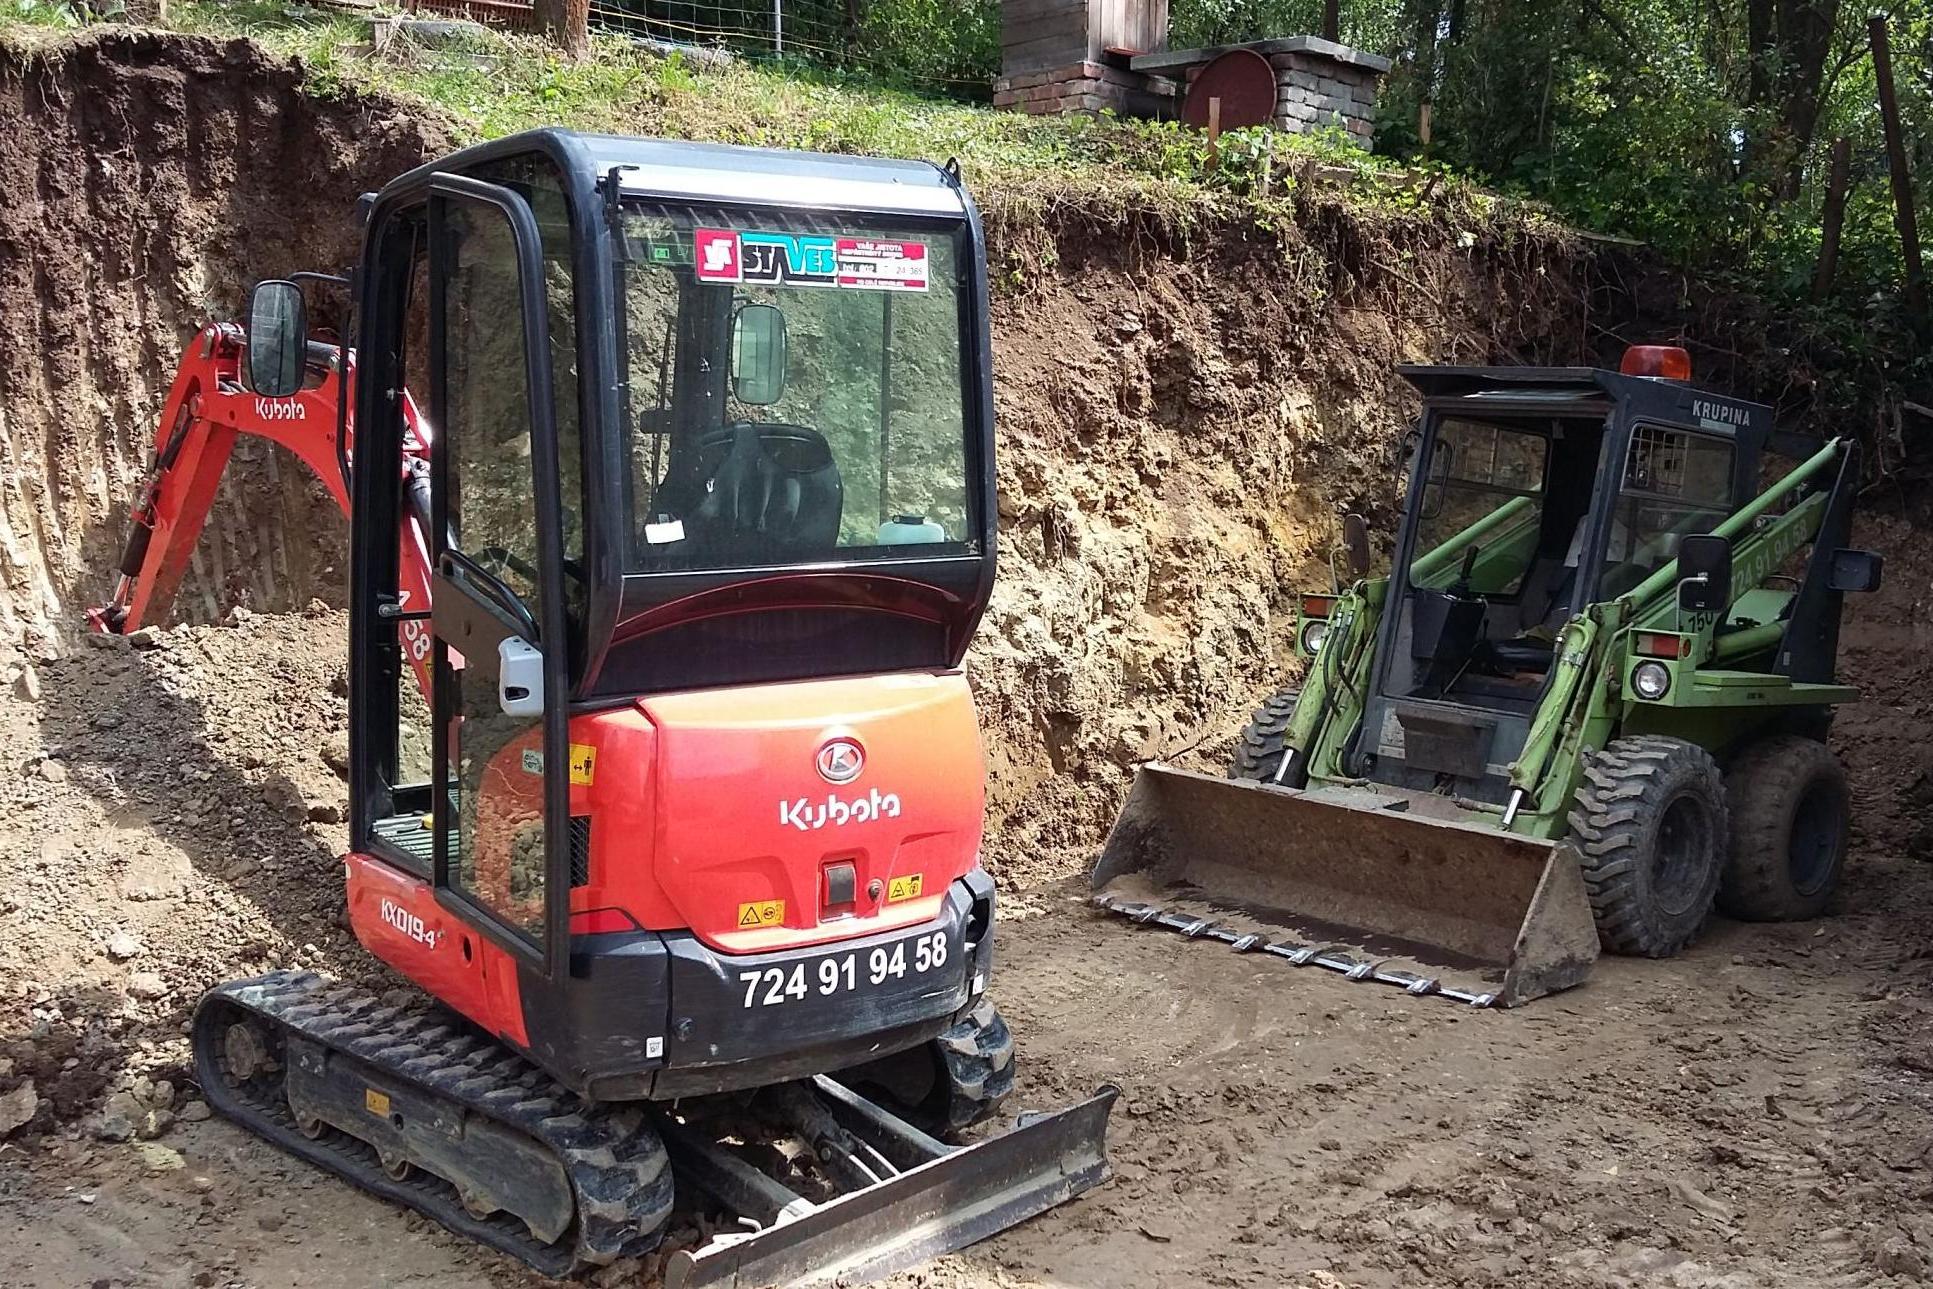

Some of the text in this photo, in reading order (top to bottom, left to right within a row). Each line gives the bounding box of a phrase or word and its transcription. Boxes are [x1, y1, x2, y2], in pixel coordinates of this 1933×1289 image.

[742, 233, 835, 283] STAVES
[255, 397, 306, 420] Kubota
[1692, 399, 1750, 426] KRUPINA
[1755, 549, 1771, 578] 91
[1774, 533, 1790, 562] 94
[1792, 519, 1808, 546] 58
[404, 619, 431, 661] 58
[779, 787, 902, 831] Kubota
[739, 931, 948, 1009] 724 91 94 58
